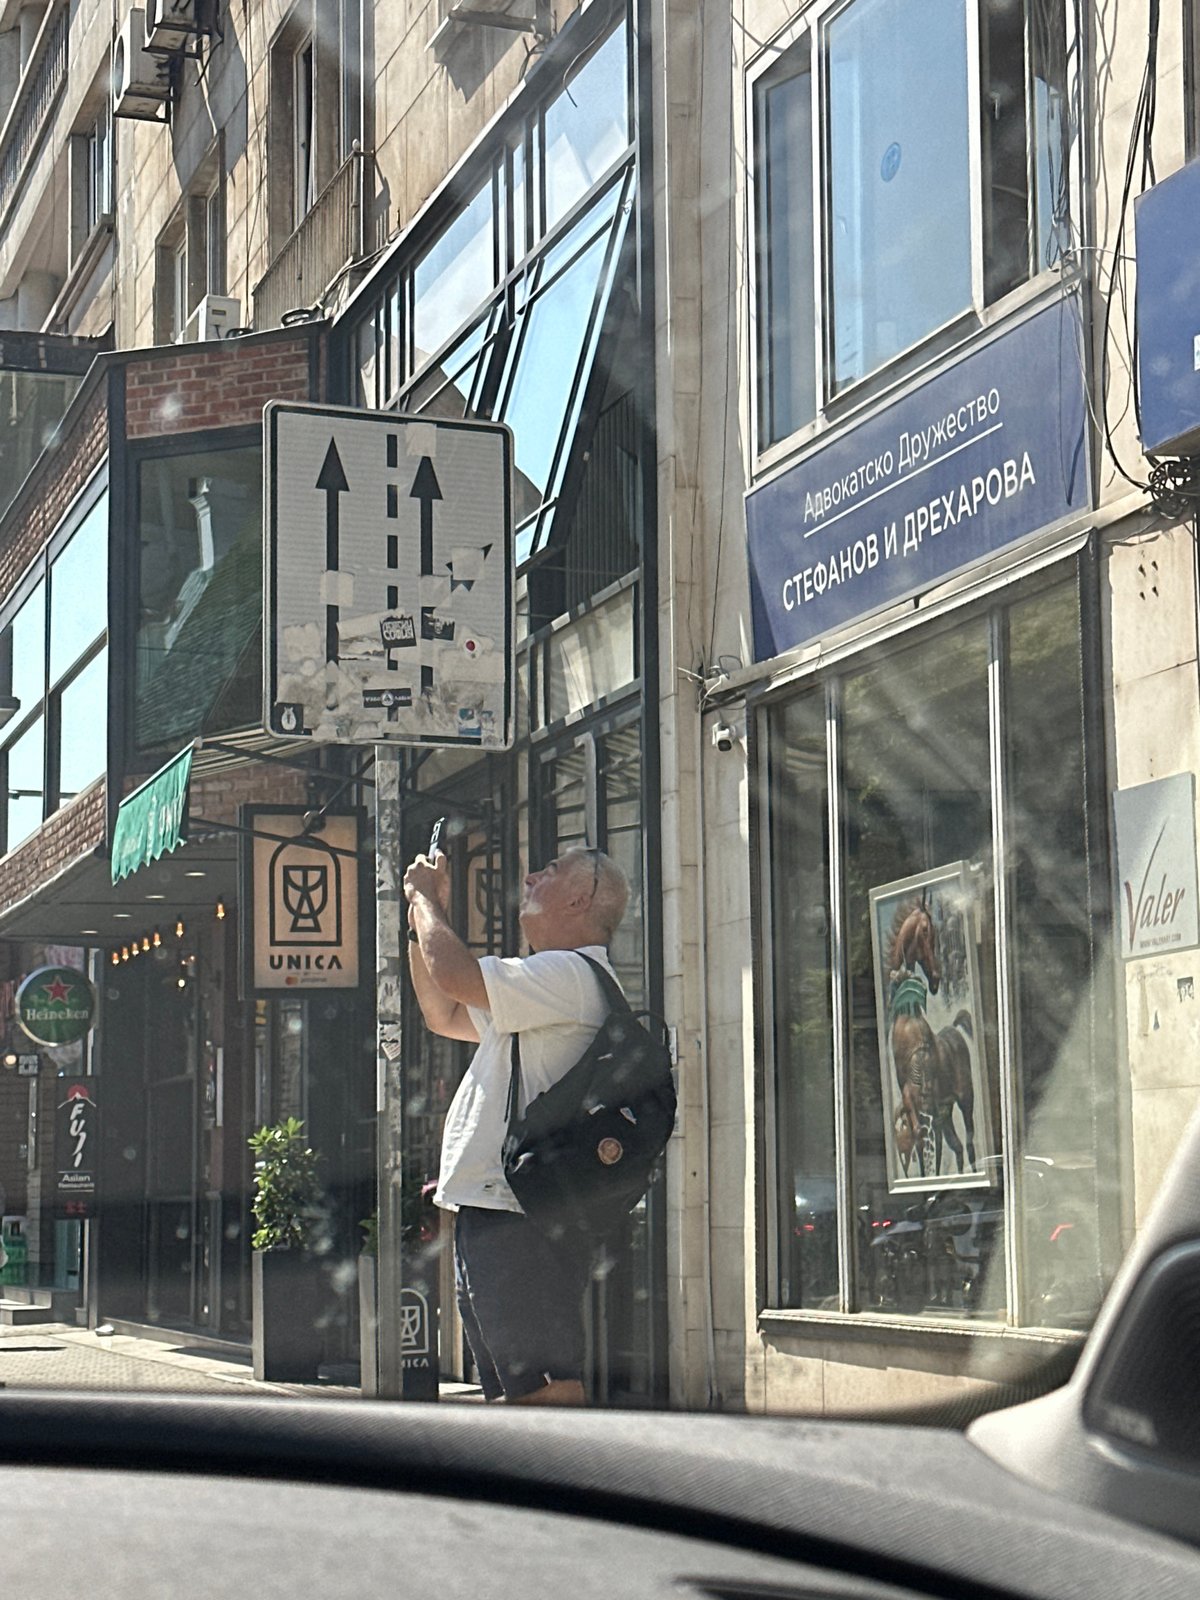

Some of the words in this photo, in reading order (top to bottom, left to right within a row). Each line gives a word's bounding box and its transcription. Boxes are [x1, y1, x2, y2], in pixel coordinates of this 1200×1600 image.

[803, 450, 894, 523] Адвокатско
[898, 388, 1000, 473] Дружество
[782, 532, 880, 612] СТЕФАНОВ
[884, 521, 898, 560] И
[903, 450, 1037, 557] ДРЕХАРОВА
[1123, 816, 1186, 953] Valer
[269, 954, 343, 970] UNICA
[26, 1007, 89, 1021] Heineken
[69, 1102, 86, 1169] FUJI
[62, 1174, 91, 1182] Asian
